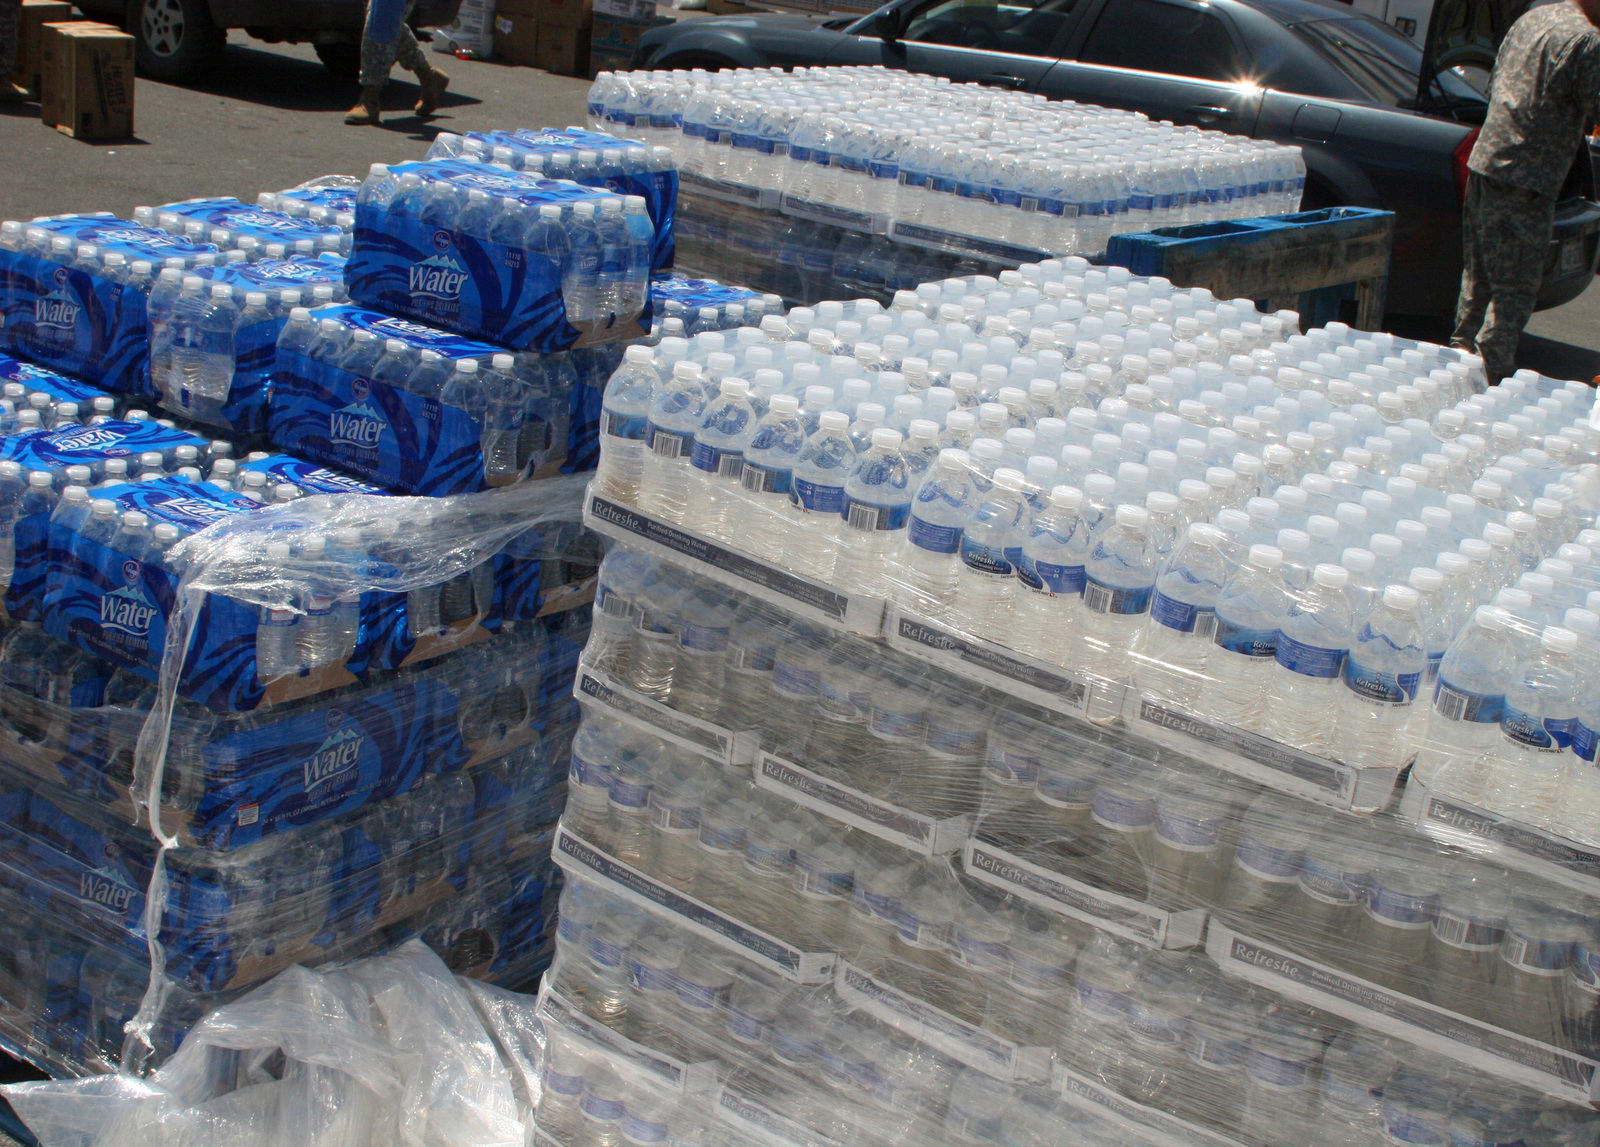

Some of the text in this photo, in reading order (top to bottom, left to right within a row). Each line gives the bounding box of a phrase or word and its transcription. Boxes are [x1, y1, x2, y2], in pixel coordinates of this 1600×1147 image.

[409, 265, 469, 294] Water
[36, 299, 81, 324] Water
[58, 429, 128, 451] Water
[330, 412, 387, 442] Water
[595, 501, 639, 529] Refreshe
[968, 551, 997, 566] Refreshe
[101, 595, 158, 629] Water
[902, 622, 956, 649] Refreshe
[1356, 677, 1389, 693] Refreshe
[1143, 706, 1204, 737] Refreshe
[304, 736, 365, 786] Water
[765, 762, 812, 791] Refreshe
[1432, 803, 1499, 837] Refreshe
[561, 837, 602, 869] Refreshe
[975, 853, 1028, 884] Refreshe
[80, 872, 137, 909] Water
[1235, 943, 1299, 977] Refreshe
[1311, 970, 1341, 986] Purified
[1341, 980, 1373, 1000] Drinking
[1374, 992, 1398, 1007] Water
